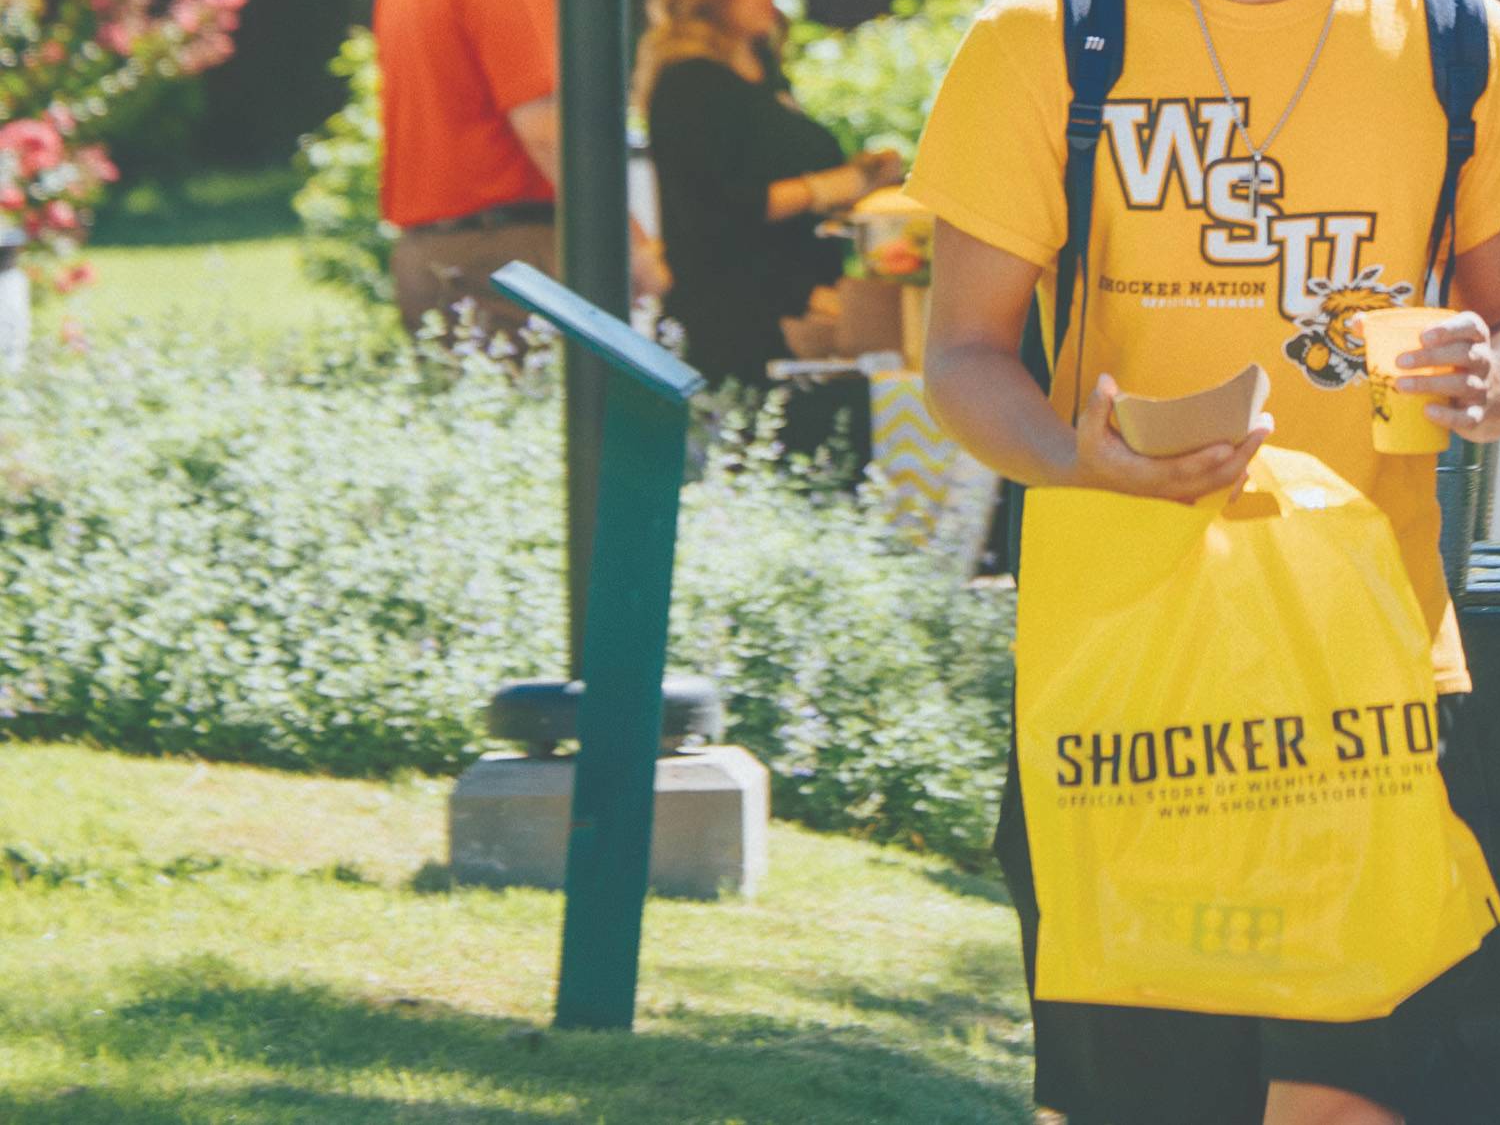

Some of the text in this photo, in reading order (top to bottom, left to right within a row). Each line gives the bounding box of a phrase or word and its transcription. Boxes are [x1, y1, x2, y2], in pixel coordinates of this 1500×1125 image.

[1100, 97, 1377, 323] WSU
[1189, 281, 1266, 295] NATION
[1057, 701, 1439, 788] SHOCKER STO
[1057, 793, 1137, 810] OFFICIAL
[1146, 785, 1206, 803] STORE
[1215, 782, 1237, 797] OF
[1248, 772, 1327, 792] WICHITA
[1338, 765, 1392, 781] STATE
